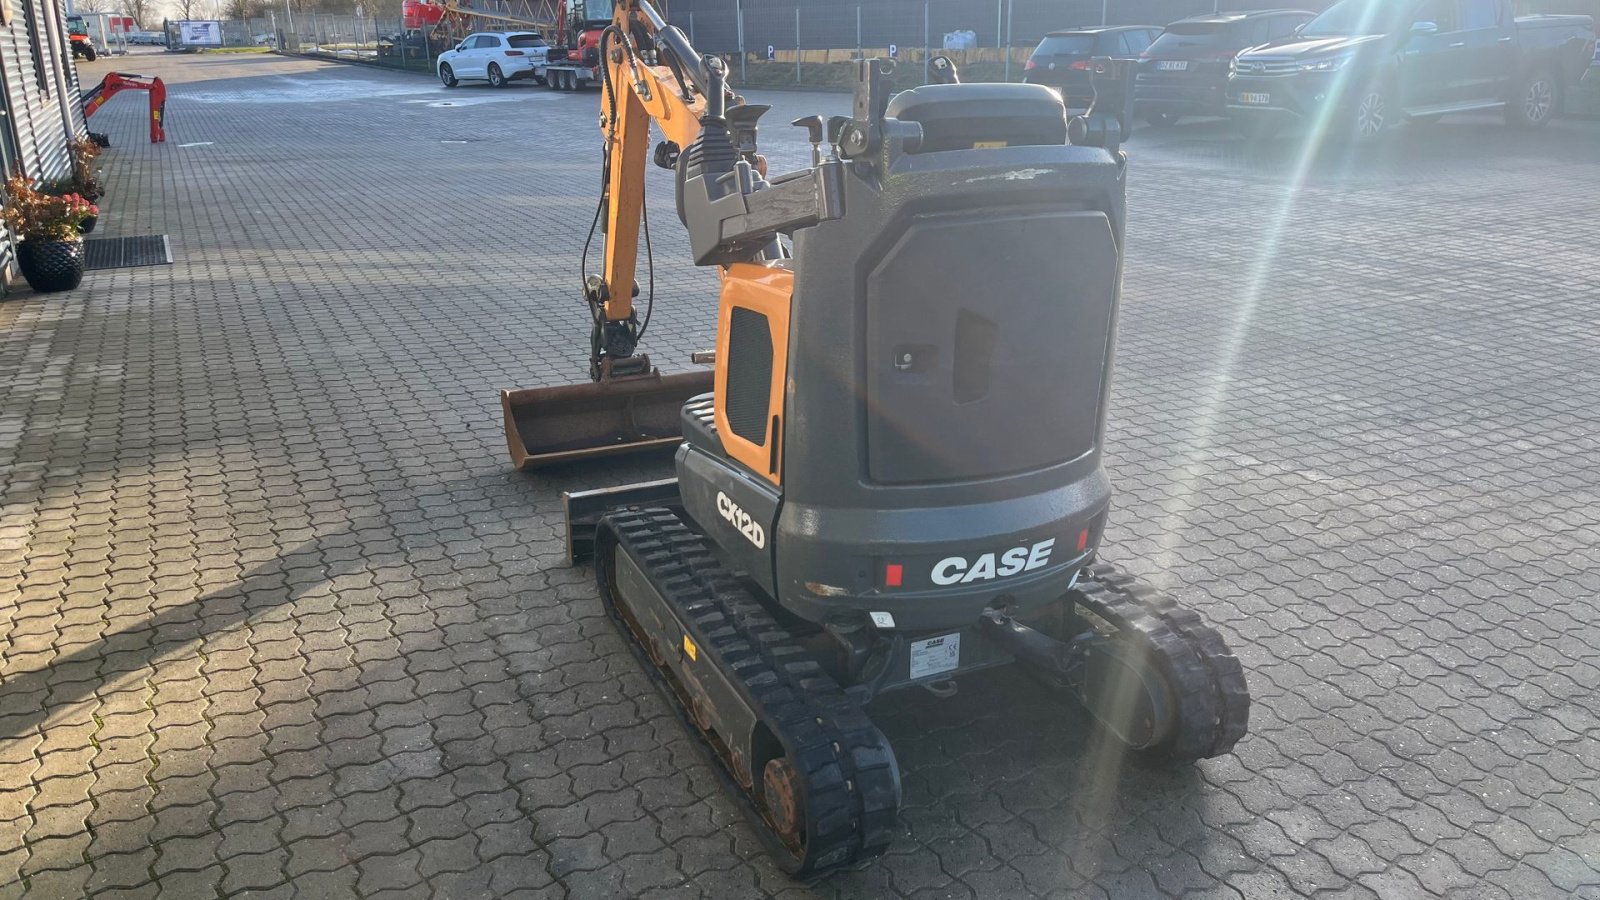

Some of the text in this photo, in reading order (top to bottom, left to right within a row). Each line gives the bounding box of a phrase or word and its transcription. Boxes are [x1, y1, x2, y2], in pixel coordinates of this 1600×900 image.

[767, 45, 774, 57] P
[889, 44, 897, 57] P
[717, 491, 765, 549] CX12D
[930, 538, 1056, 585] CASE
